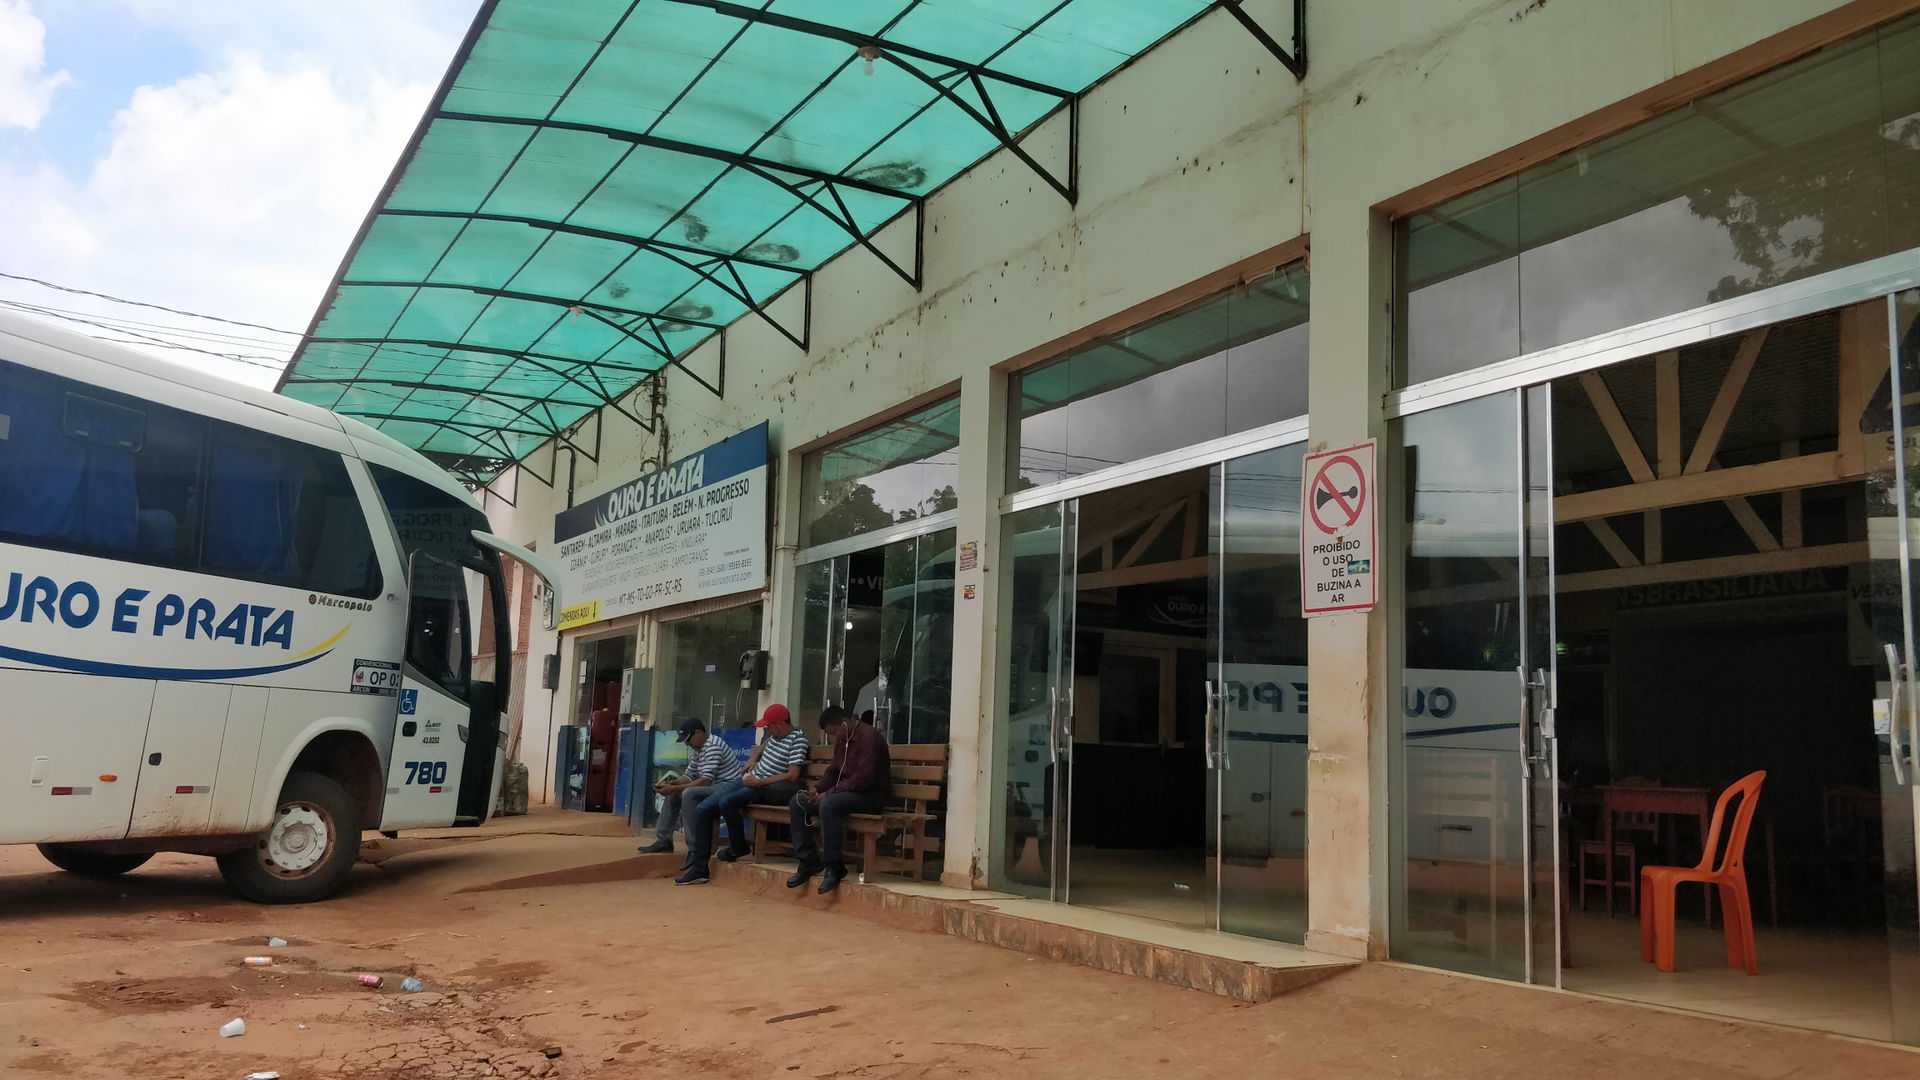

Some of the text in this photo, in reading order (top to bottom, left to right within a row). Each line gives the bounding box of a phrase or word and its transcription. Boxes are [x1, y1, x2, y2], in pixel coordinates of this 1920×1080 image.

[607, 454, 705, 524] OURO E PRATA
[641, 506, 668, 529] ITAITUBA
[672, 493, 693, 518] BELÉM
[698, 495, 704, 509] N.
[706, 478, 749, 507] PROGRESSO
[1313, 540, 1360, 555] PROIBIDO
[1322, 554, 1354, 566] O USO
[1331, 568, 1345, 578] DE
[1317, 579, 1361, 592] BUZINA A
[317, 595, 373, 612] Marcopolo
[1331, 594, 1345, 603] AR
[0, 572, 295, 650] URO E PRATA
[370, 671, 387, 685] OP
[404, 761, 448, 785] 780
